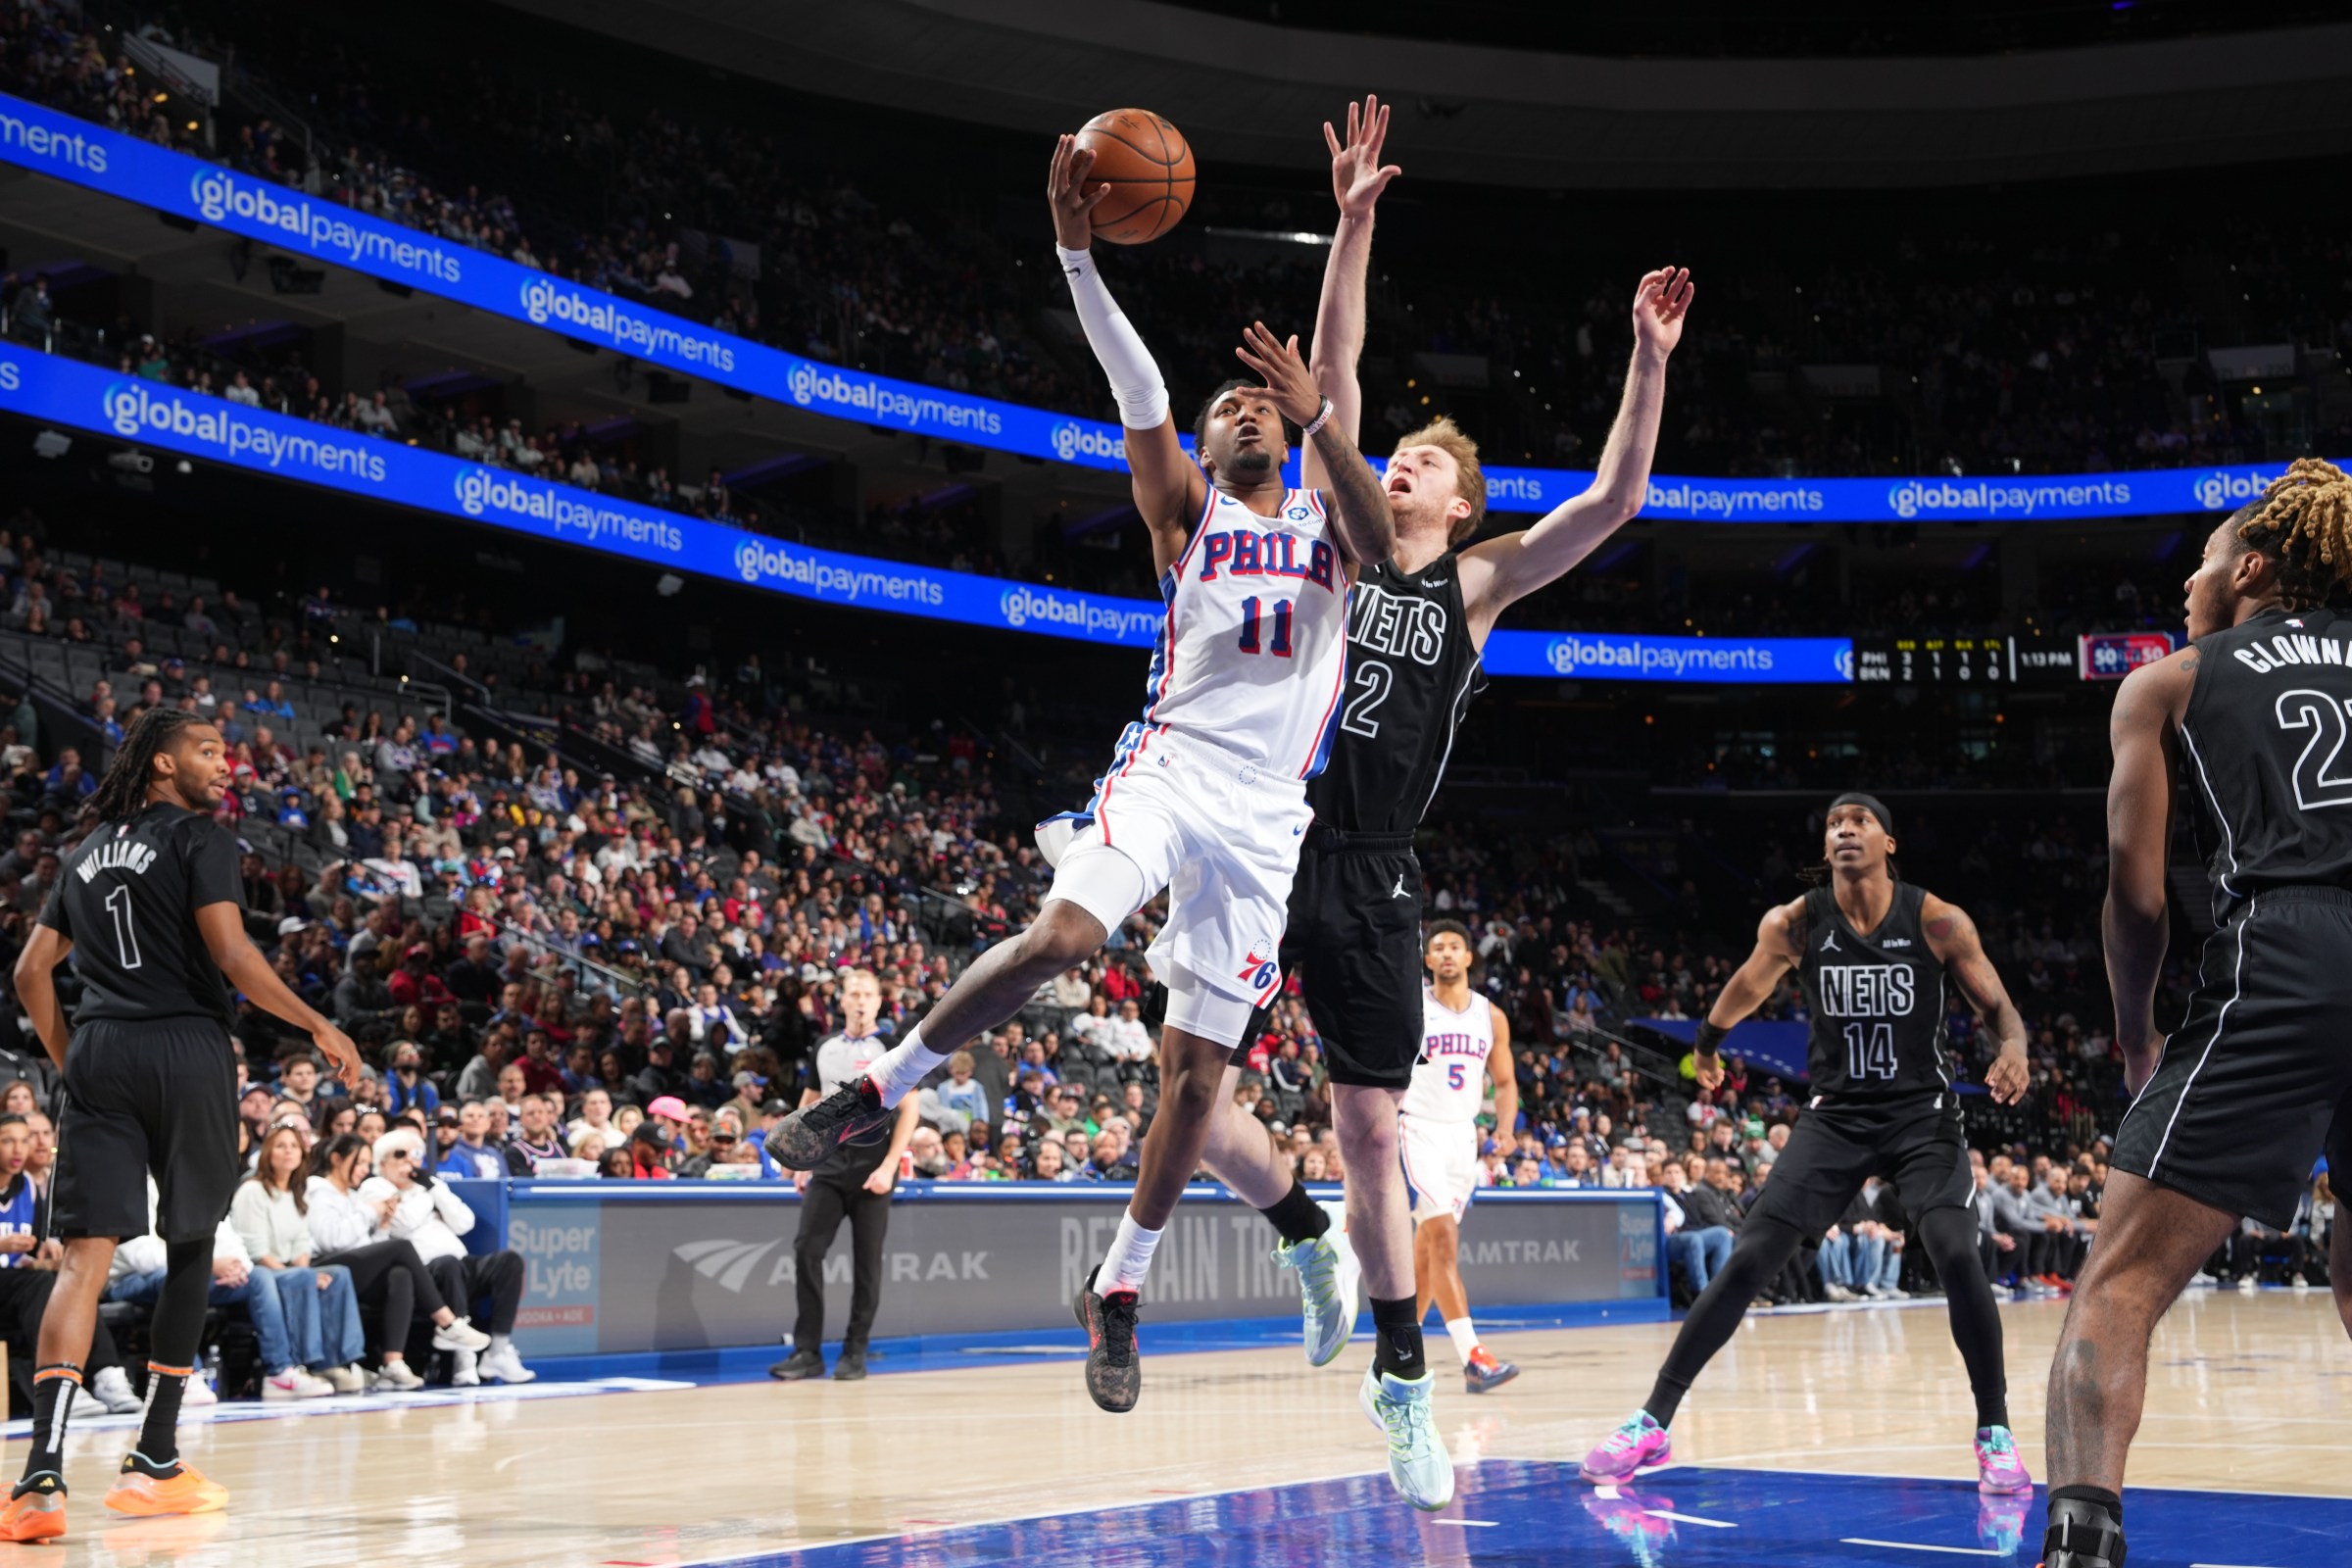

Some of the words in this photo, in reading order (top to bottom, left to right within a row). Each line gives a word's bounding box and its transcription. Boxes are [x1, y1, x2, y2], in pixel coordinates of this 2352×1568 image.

[199, 172, 461, 282] globalpayments
[526, 278, 735, 371] globalpayments
[793, 361, 1002, 435] globalpayments
[111, 384, 385, 482] globalpayments
[457, 471, 682, 553] globalpayments
[1896, 480, 2131, 517] globalpayments
[741, 540, 943, 607] globalpayments
[1200, 530, 1335, 593] PHILA
[1238, 595, 1293, 658] 11
[1347, 582, 1446, 665] NETS
[1554, 637, 1773, 674] globalpayments
[1859, 666, 1890, 680] BKN
[1903, 666, 1912, 680] 2
[1959, 665, 1971, 680] 0
[1987, 665, 2000, 680] 0
[1862, 652, 1887, 665] PHI
[2048, 652, 2072, 665] PM
[2094, 647, 2118, 666] 50
[2233, 634, 2352, 673] CLOWN
[1341, 660, 1393, 738] 2
[2276, 689, 2352, 810] 2
[75, 840, 157, 883] WILLIAMS
[105, 884, 142, 970] 1
[1239, 951, 1277, 990] 76
[1820, 963, 1914, 1017] NETS
[1426, 1033, 1487, 1061] PHILA
[1843, 1022, 1897, 1079] 14
[1447, 1063, 1466, 1091] 5
[507, 1219, 595, 1260] Super
[1458, 1240, 1581, 1264] AMTRAK
[530, 1259, 591, 1298] Lyte
[768, 1251, 990, 1287] AMRAK
